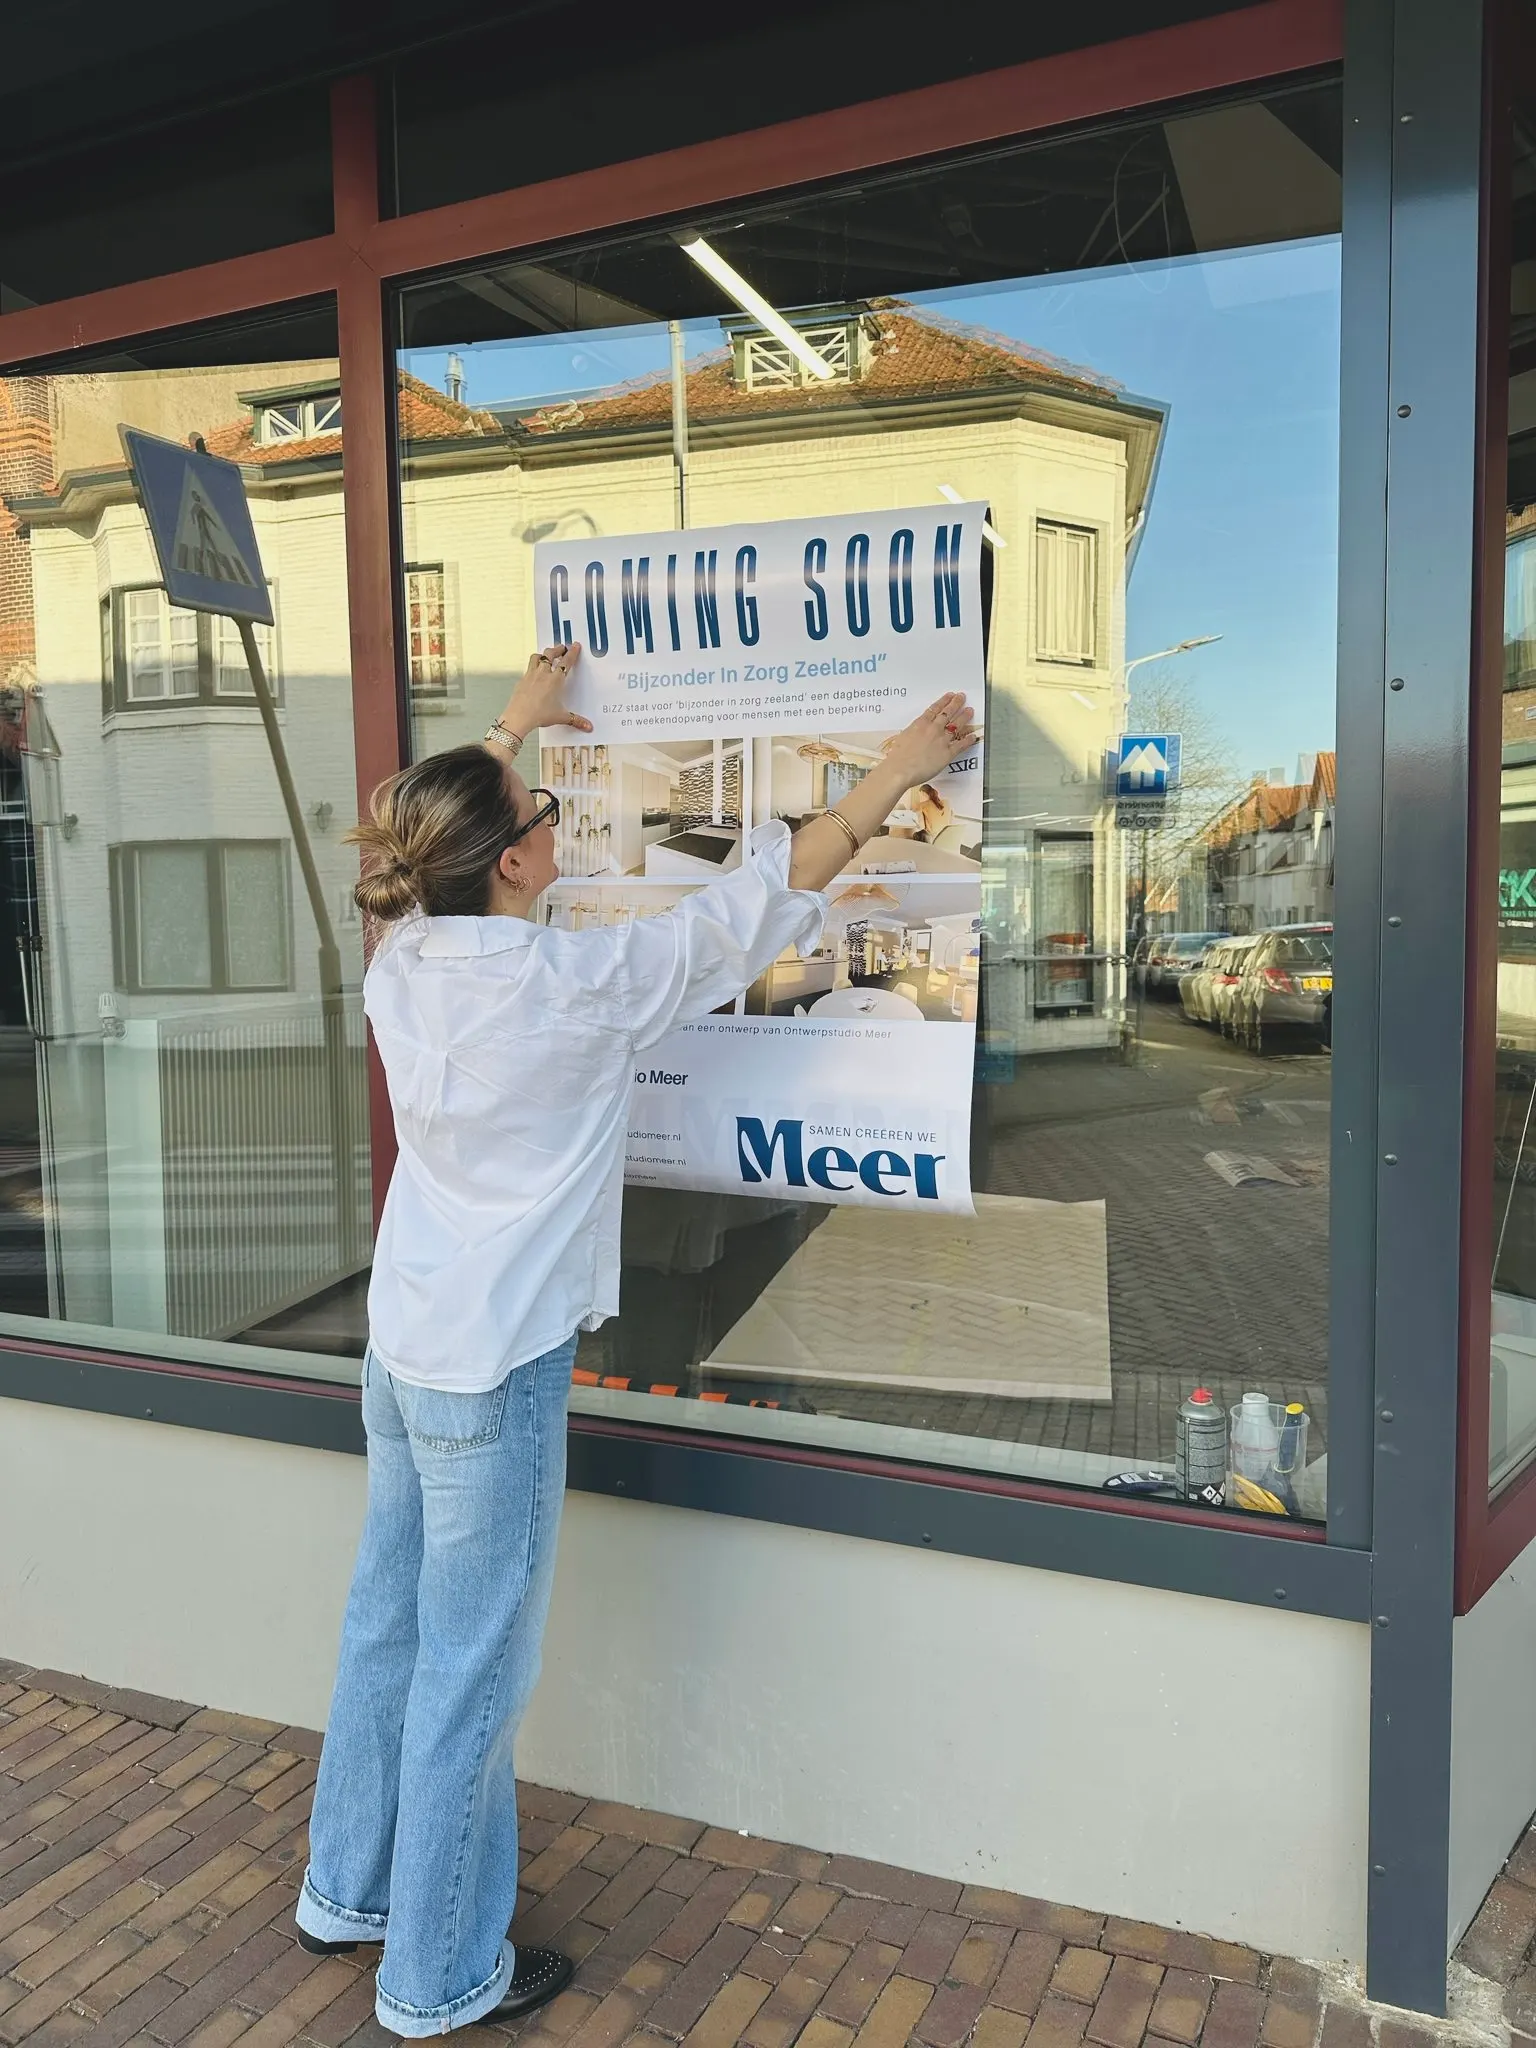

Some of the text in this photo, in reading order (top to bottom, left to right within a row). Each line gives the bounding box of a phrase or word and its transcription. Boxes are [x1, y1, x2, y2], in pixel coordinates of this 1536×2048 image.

[549, 523, 963, 658] COMING SOON
[720, 667, 738, 683] In
[743, 664, 789, 684] Zorg
[626, 702, 649, 713] staat
[652, 702, 674, 711] voor
[727, 697, 737, 707] in
[739, 696, 761, 707] zorg
[810, 692, 830, 701] een
[833, 685, 908, 702] dagbesteding
[621, 702, 885, 728] en weekendopvang voor mensen met een beperking.
[697, 1024, 716, 1032] een
[718, 1024, 760, 1035] ontwerp
[762, 1026, 781, 1035] van
[783, 1025, 862, 1038] Ontwerpstudio
[864, 1028, 892, 1039] Meer
[649, 1069, 689, 1086] Meer
[808, 1124, 852, 1137] SAMEN
[916, 1131, 937, 1143] WE
[735, 1116, 947, 1200] Meer
